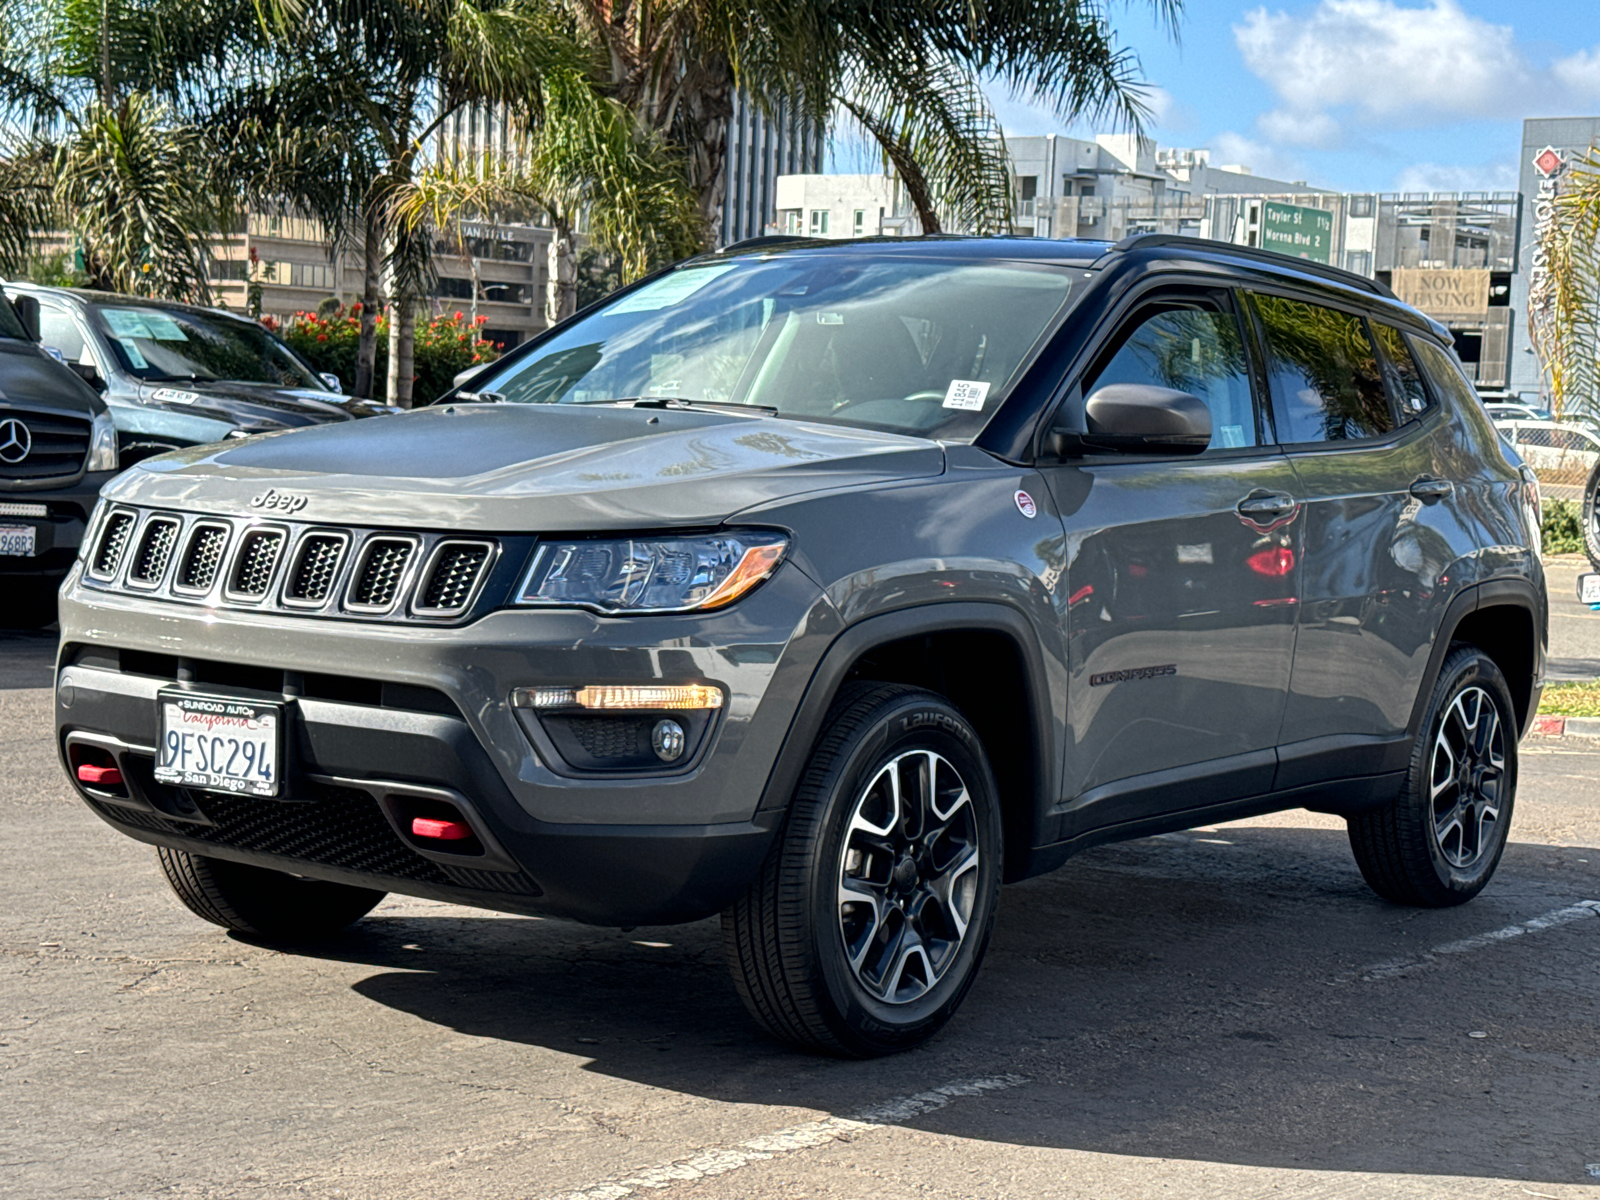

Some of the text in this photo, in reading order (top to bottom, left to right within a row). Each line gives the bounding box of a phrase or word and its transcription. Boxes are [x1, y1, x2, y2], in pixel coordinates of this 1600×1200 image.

[1267, 208, 1291, 224] Taylor
[1293, 212, 1303, 225] St
[1265, 228, 1321, 247] Morena Blvd 2
[1421, 275, 1462, 290] NOW
[1404, 291, 1475, 308] LEASING
[950, 383, 970, 407] 11845
[251, 488, 308, 515] Jeep
[1089, 664, 1177, 687] COMPASS
[184, 700, 249, 715] SUNROAD AUTO
[183, 712, 258, 731] California
[167, 730, 272, 781] 9FSC294
[184, 771, 207, 785] San
[210, 775, 245, 791] Diego
